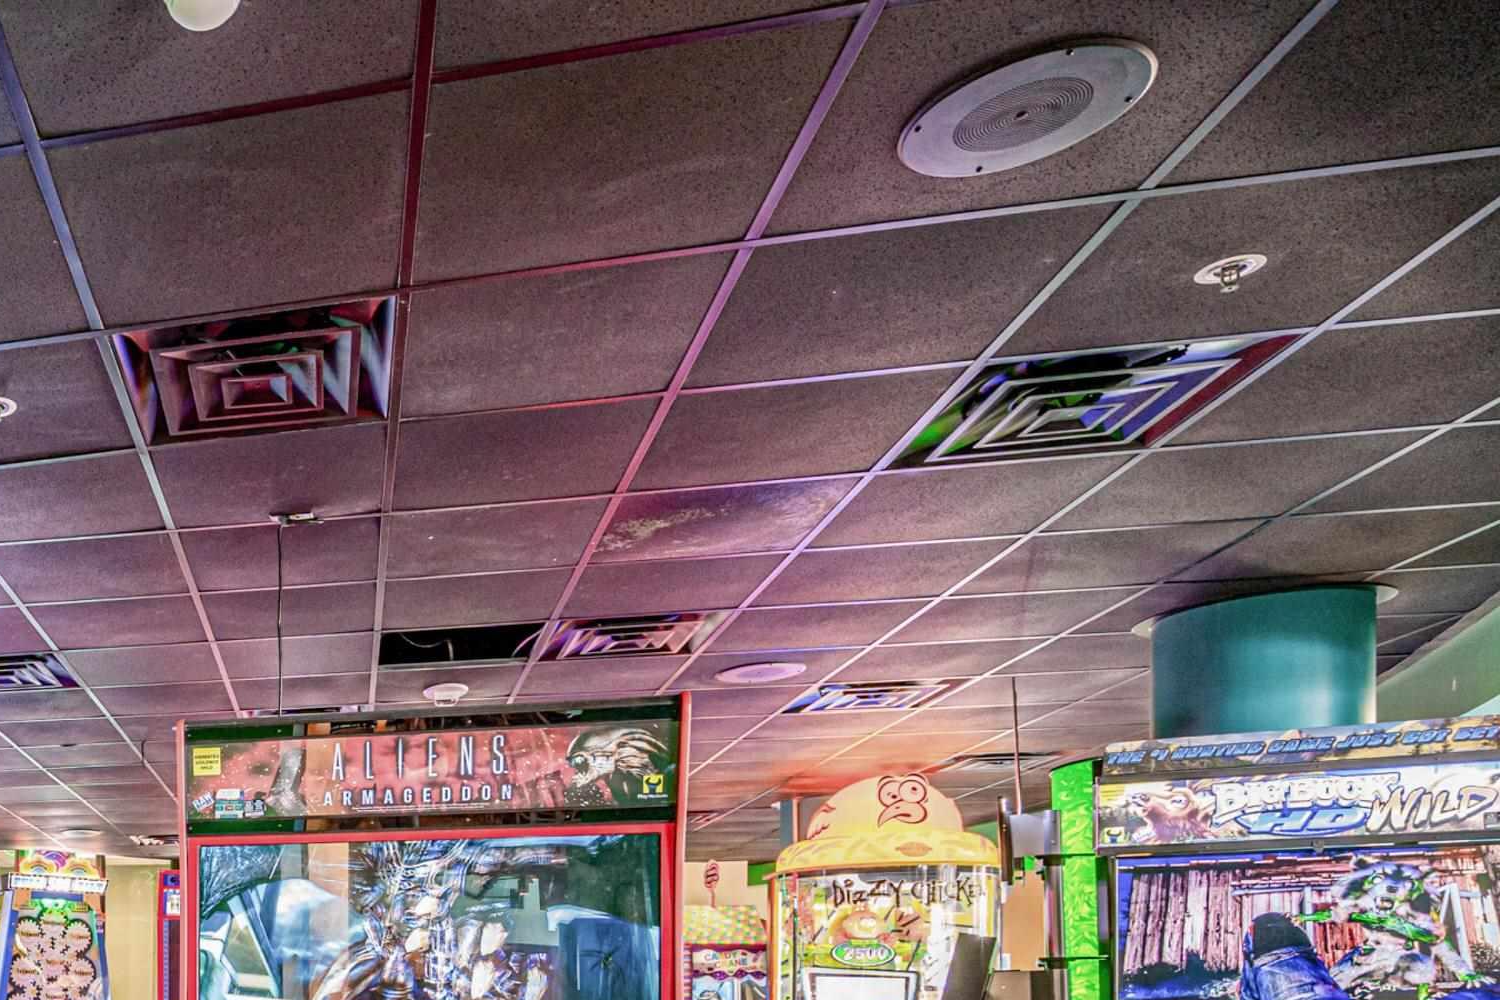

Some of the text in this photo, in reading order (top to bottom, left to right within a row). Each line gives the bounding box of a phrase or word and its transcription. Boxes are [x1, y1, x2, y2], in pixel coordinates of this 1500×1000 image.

[1268, 736, 1335, 753] GAME
[1335, 731, 1400, 750] JUST
[1402, 728, 1452, 745] GOT
[331, 734, 509, 781] ALIENS
[323, 784, 513, 807] ARMAGEDDON
[1244, 807, 1369, 833] HD
[1365, 786, 1500, 834] WILD
[843, 948, 888, 961] 2500
